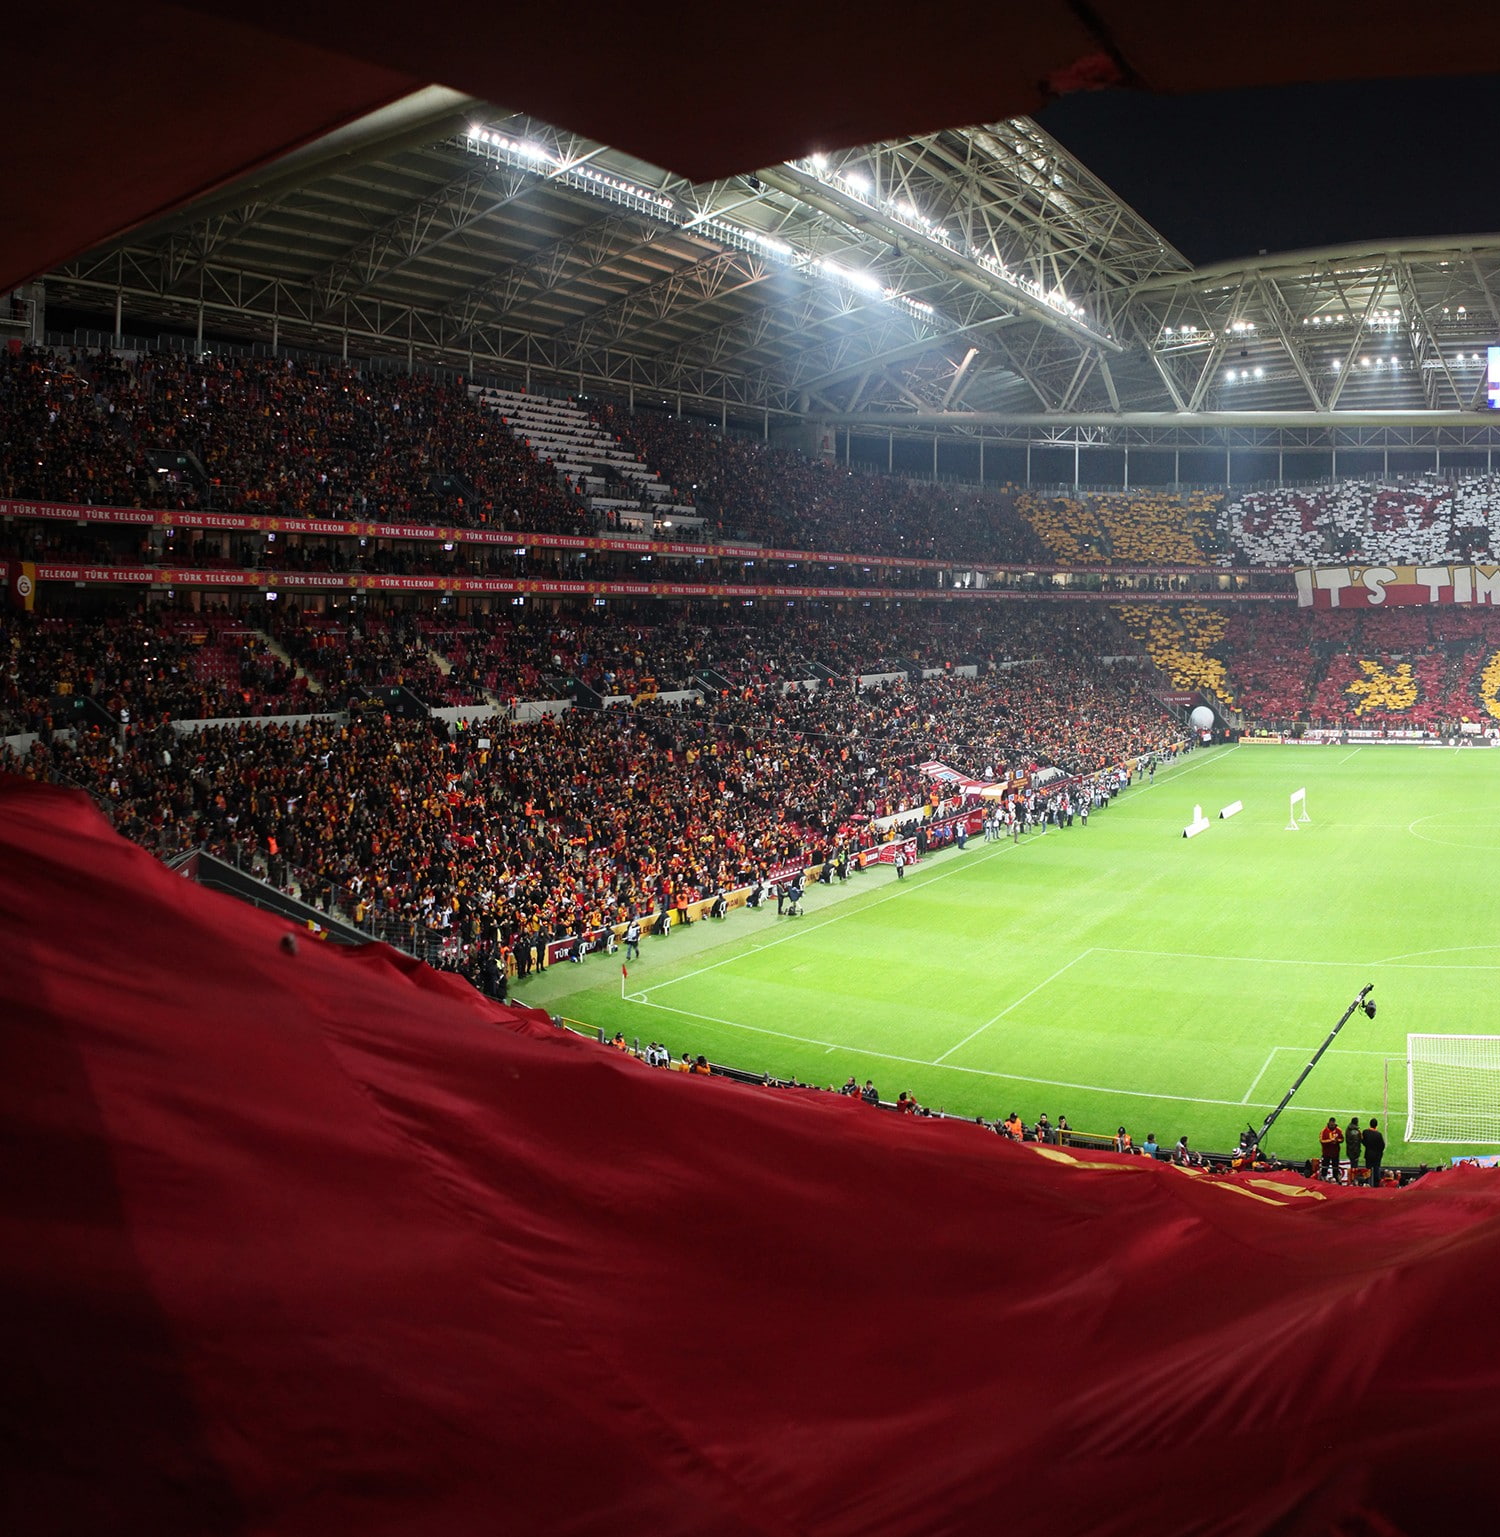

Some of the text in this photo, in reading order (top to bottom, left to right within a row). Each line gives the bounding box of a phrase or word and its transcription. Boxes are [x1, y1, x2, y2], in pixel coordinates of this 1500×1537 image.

[13, 505, 37, 514] TÜRK
[41, 507, 80, 517] TELEKOM
[86, 510, 154, 521] TÜRK TELEKOM
[179, 515, 245, 526] TÜRK TELEKOM
[285, 521, 344, 532] TÜRK TELEKOM
[381, 527, 435, 537] TÜRK TELEKOM
[466, 532, 513, 542] TÜRK TELEKOM
[542, 537, 585, 546] TÜRK TELEKOM
[611, 541, 625, 549] TÜRK
[39, 570, 78, 579] TELEKOM
[85, 570, 153, 580] TÜRK TELEKOM
[206, 574, 244, 582] TELEKOM
[284, 576, 344, 585] TÜRK TELEKOM
[380, 579, 400, 587] TÜRK
[466, 581, 513, 590] TÜRK TELEKOM
[542, 583, 558, 591] TÜRK
[610, 584, 625, 592] TÜRK
[1295, 566, 1398, 607] IT'S
[555, 947, 572, 959] TÜR
